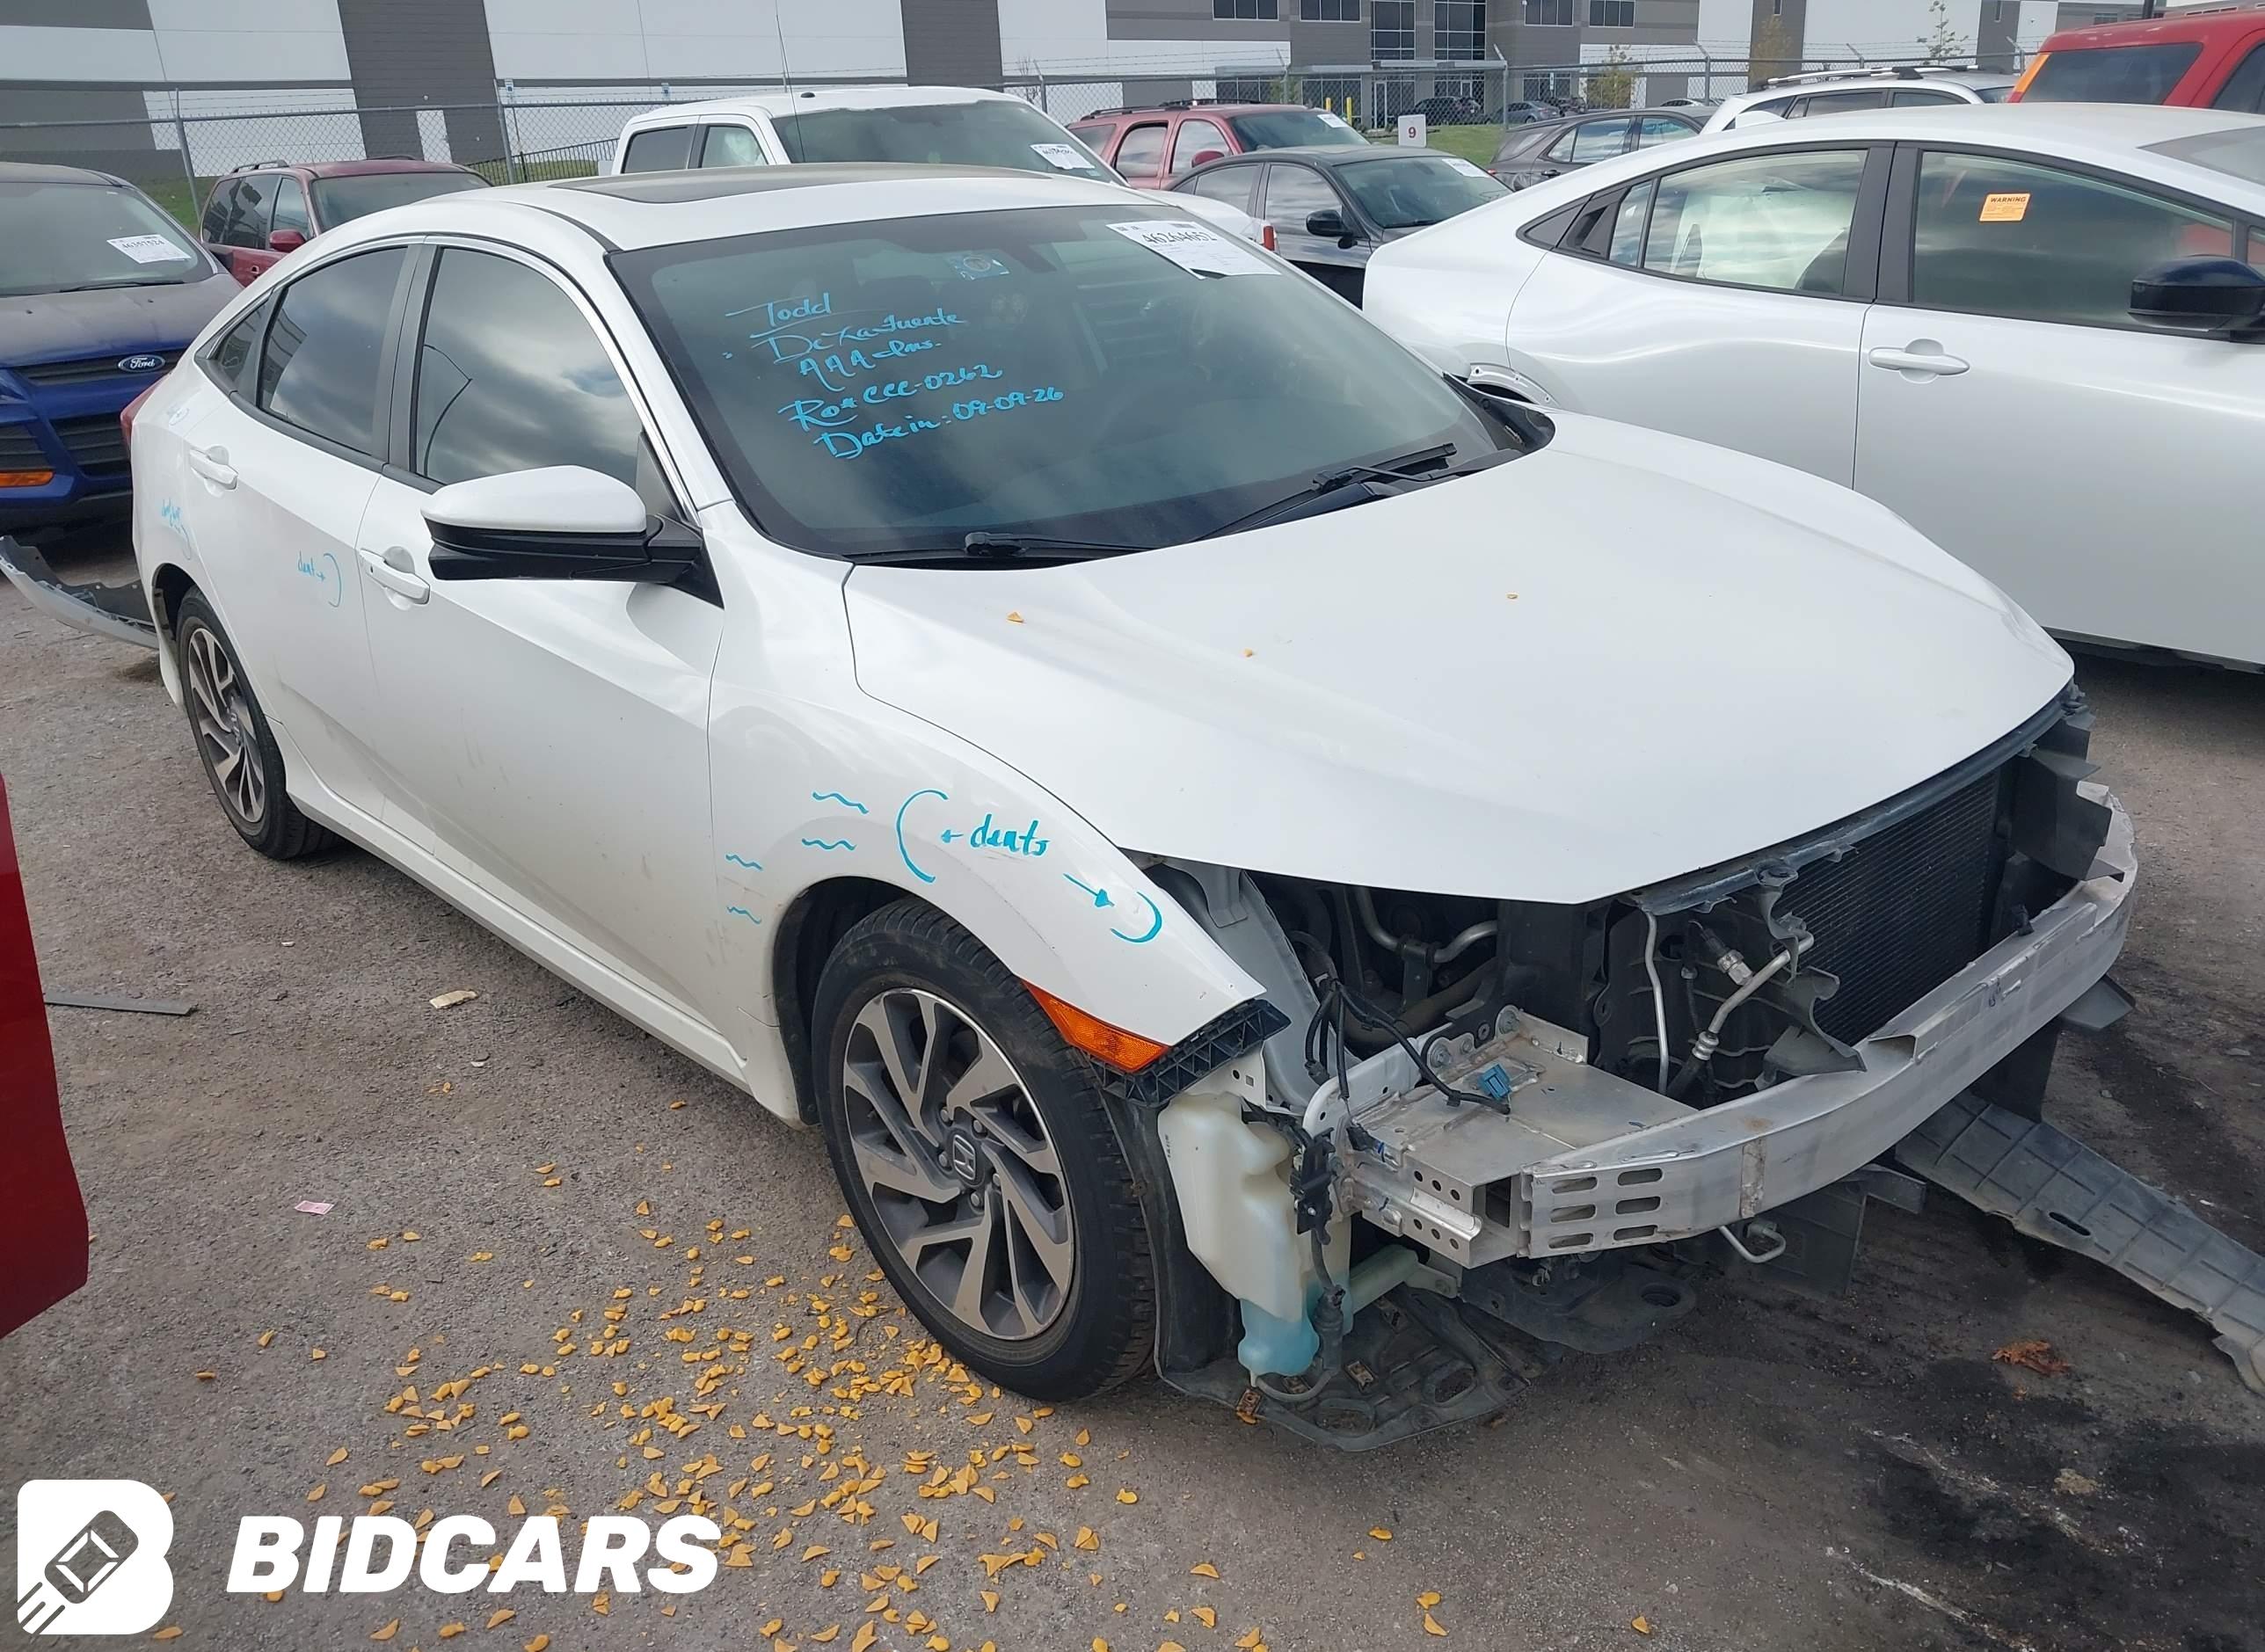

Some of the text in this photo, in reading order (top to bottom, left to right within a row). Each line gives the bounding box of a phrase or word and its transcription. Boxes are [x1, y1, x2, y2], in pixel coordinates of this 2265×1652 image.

[1408, 126, 1417, 139] 9
[1141, 231, 1218, 244] 46264652
[725, 292, 833, 327] Todd
[129, 357, 156, 369] Ford
[970, 813, 1051, 856] dents
